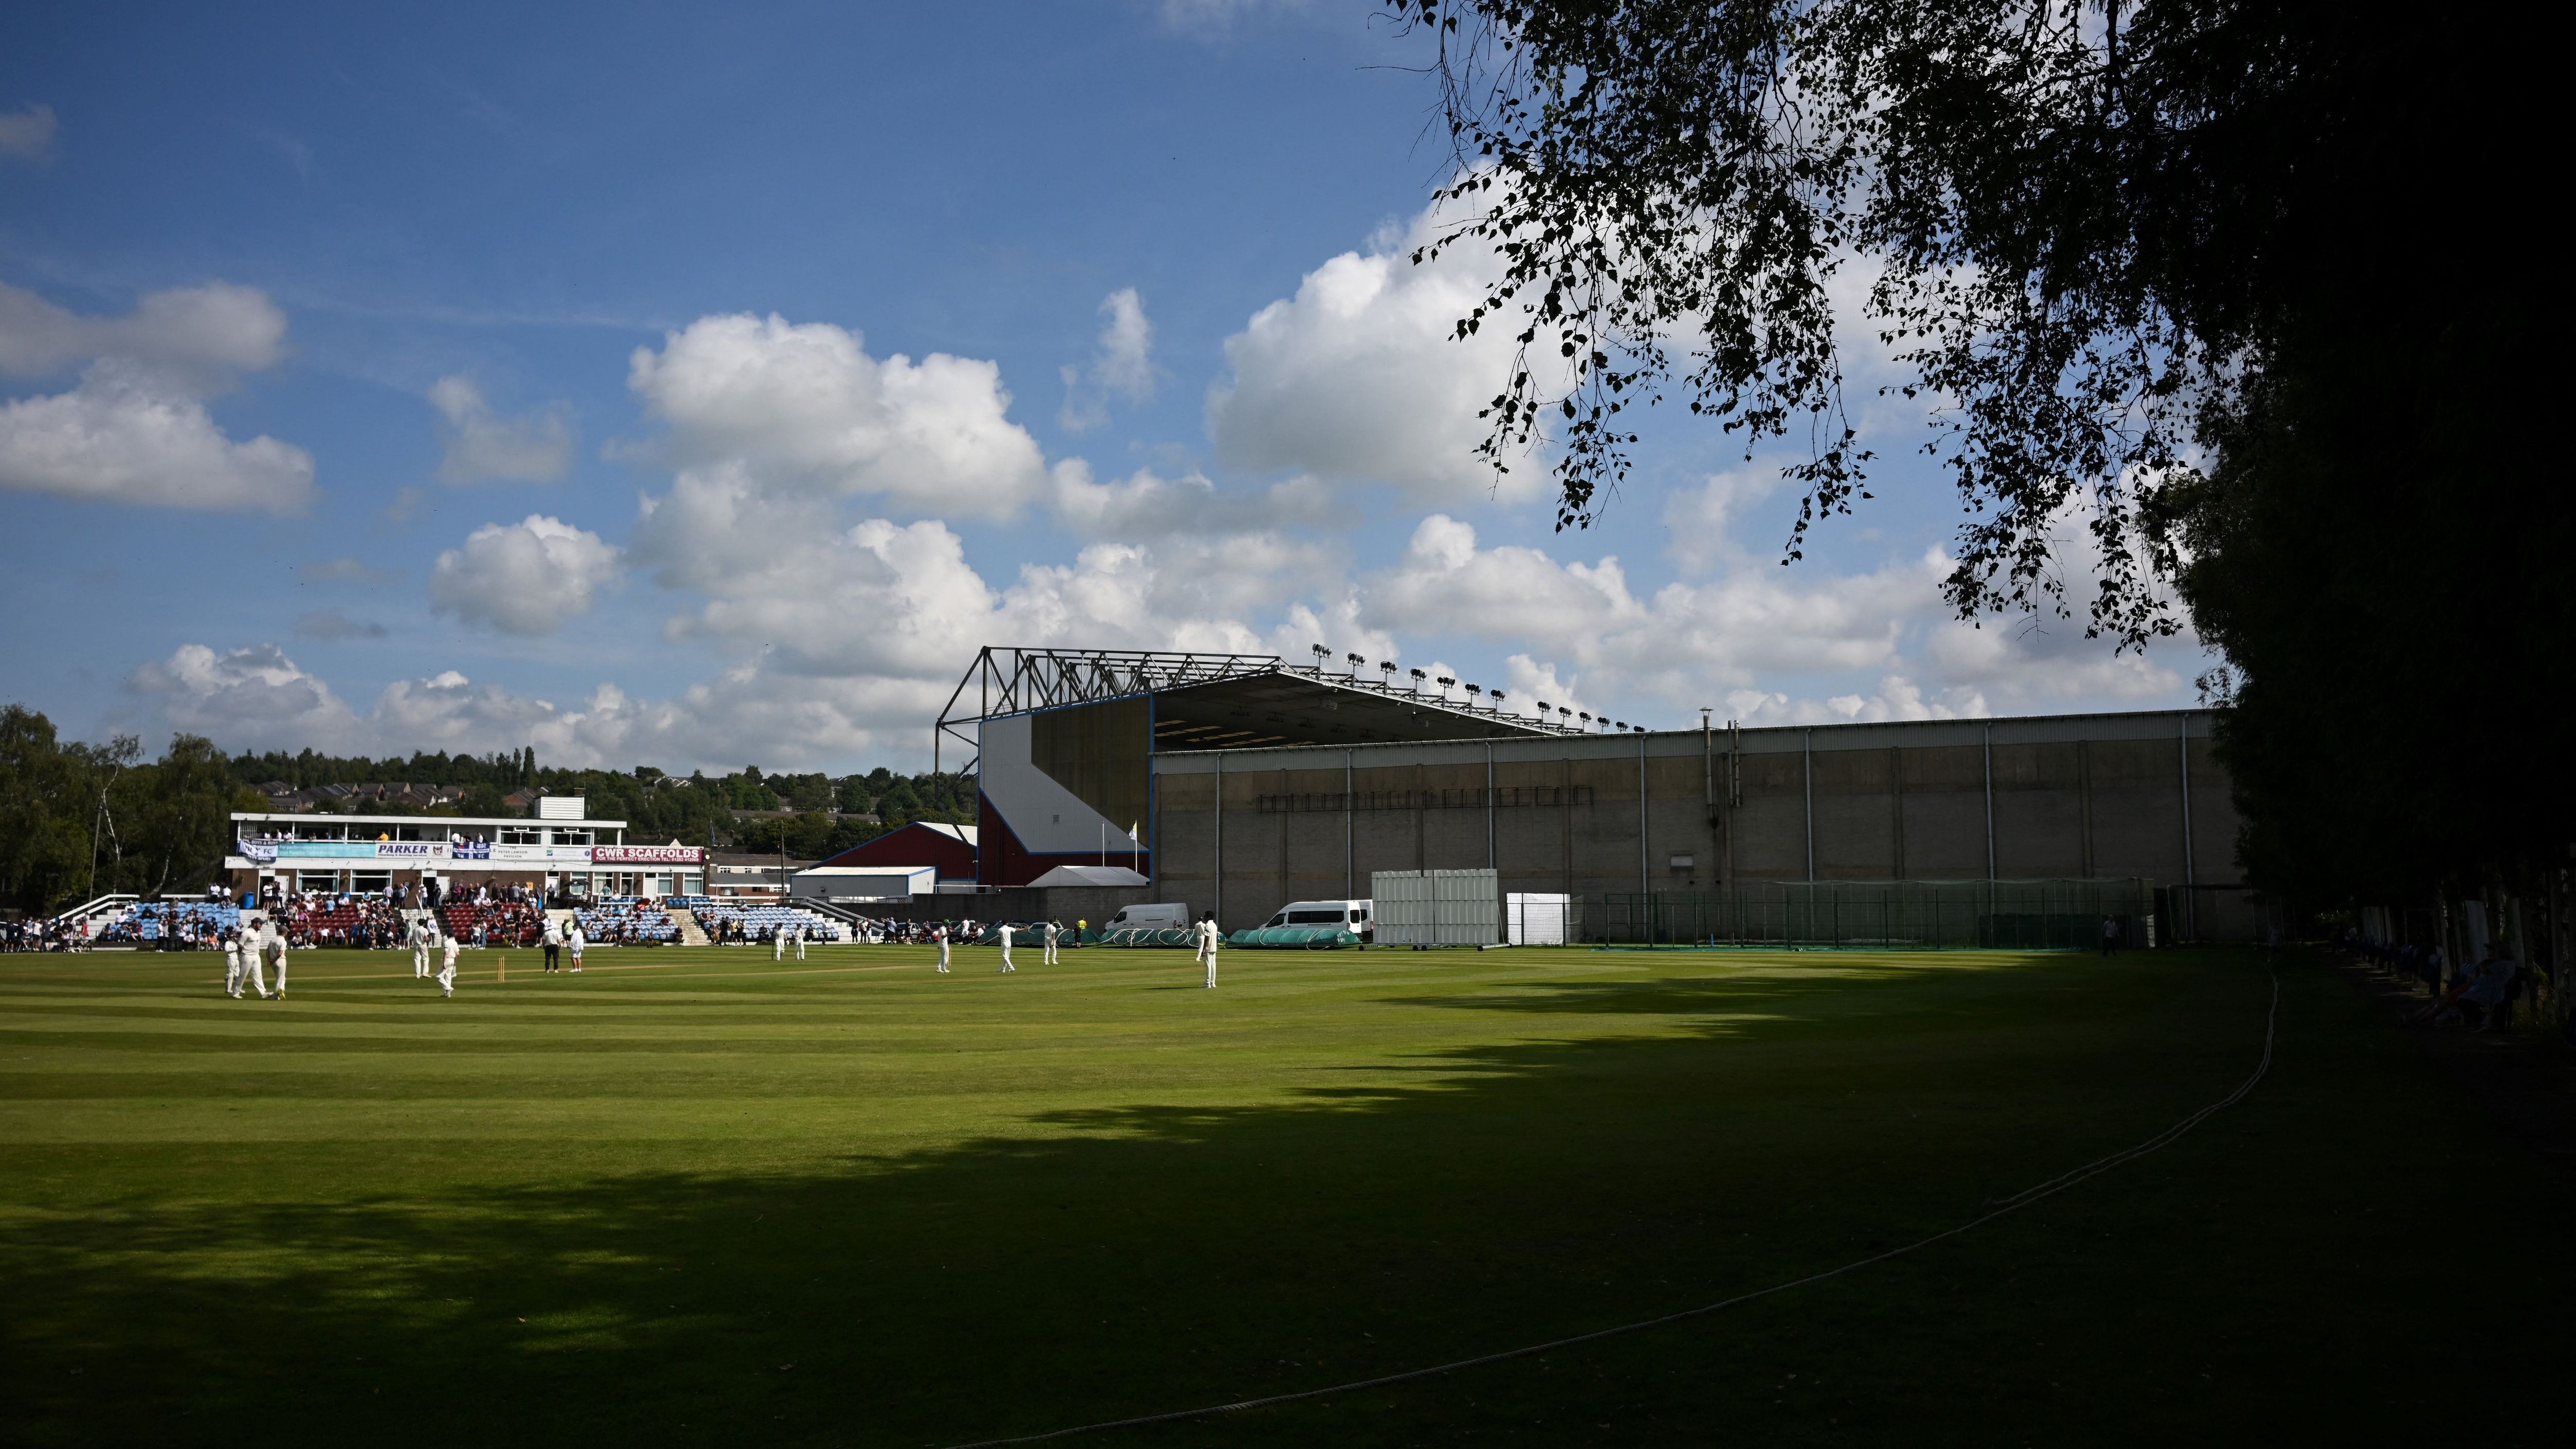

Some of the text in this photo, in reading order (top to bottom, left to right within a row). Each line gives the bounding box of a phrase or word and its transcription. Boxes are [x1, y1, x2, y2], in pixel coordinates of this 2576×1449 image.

[378, 845, 428, 854] PARKER
[596, 848, 699, 858] CWR SCAFFOLDS
